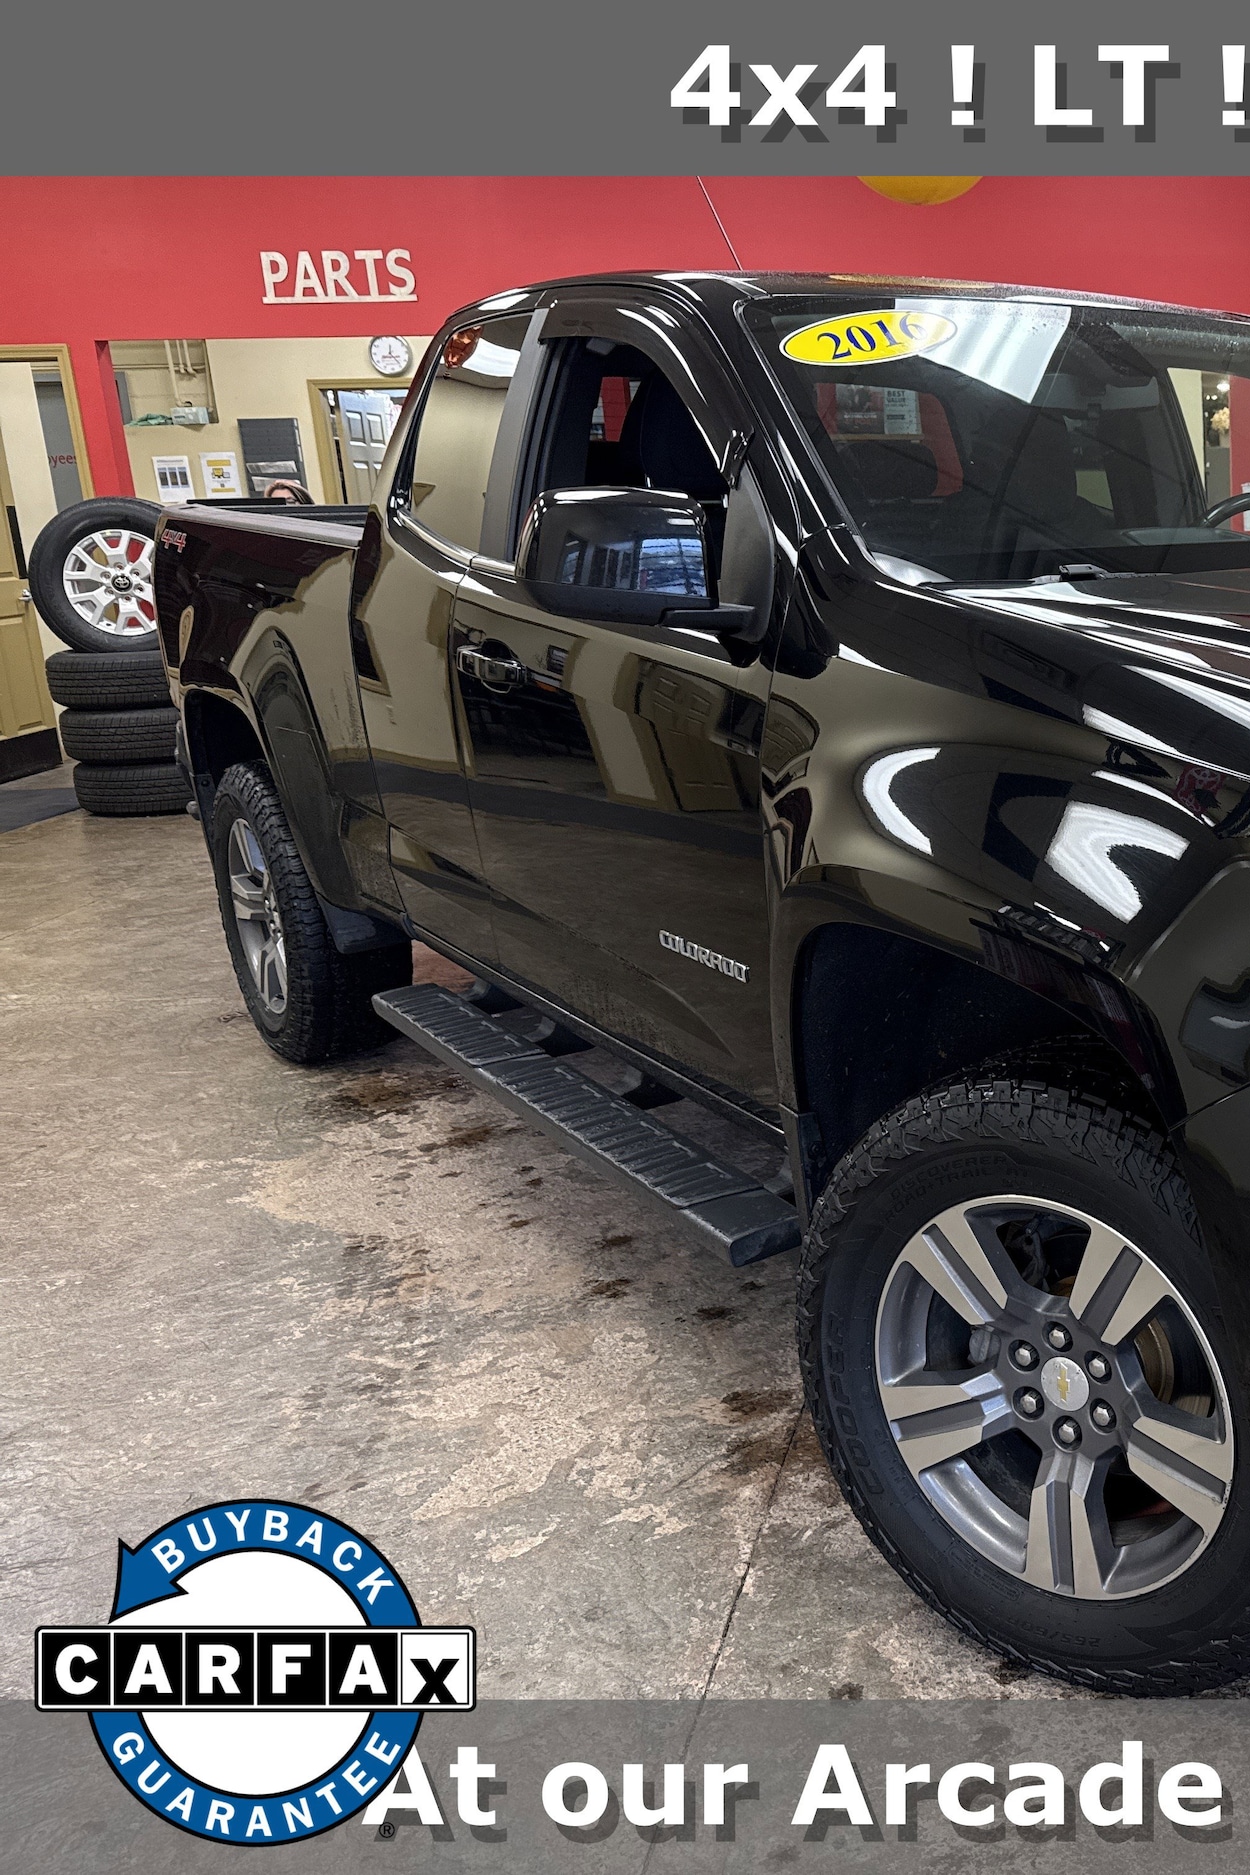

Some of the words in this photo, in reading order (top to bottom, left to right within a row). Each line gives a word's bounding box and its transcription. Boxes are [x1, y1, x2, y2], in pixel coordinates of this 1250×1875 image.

[259, 248, 418, 304] PARTS
[816, 311, 928, 360] 2016
[659, 929, 750, 984] COLORADO
[827, 1310, 884, 1495] COOPER
